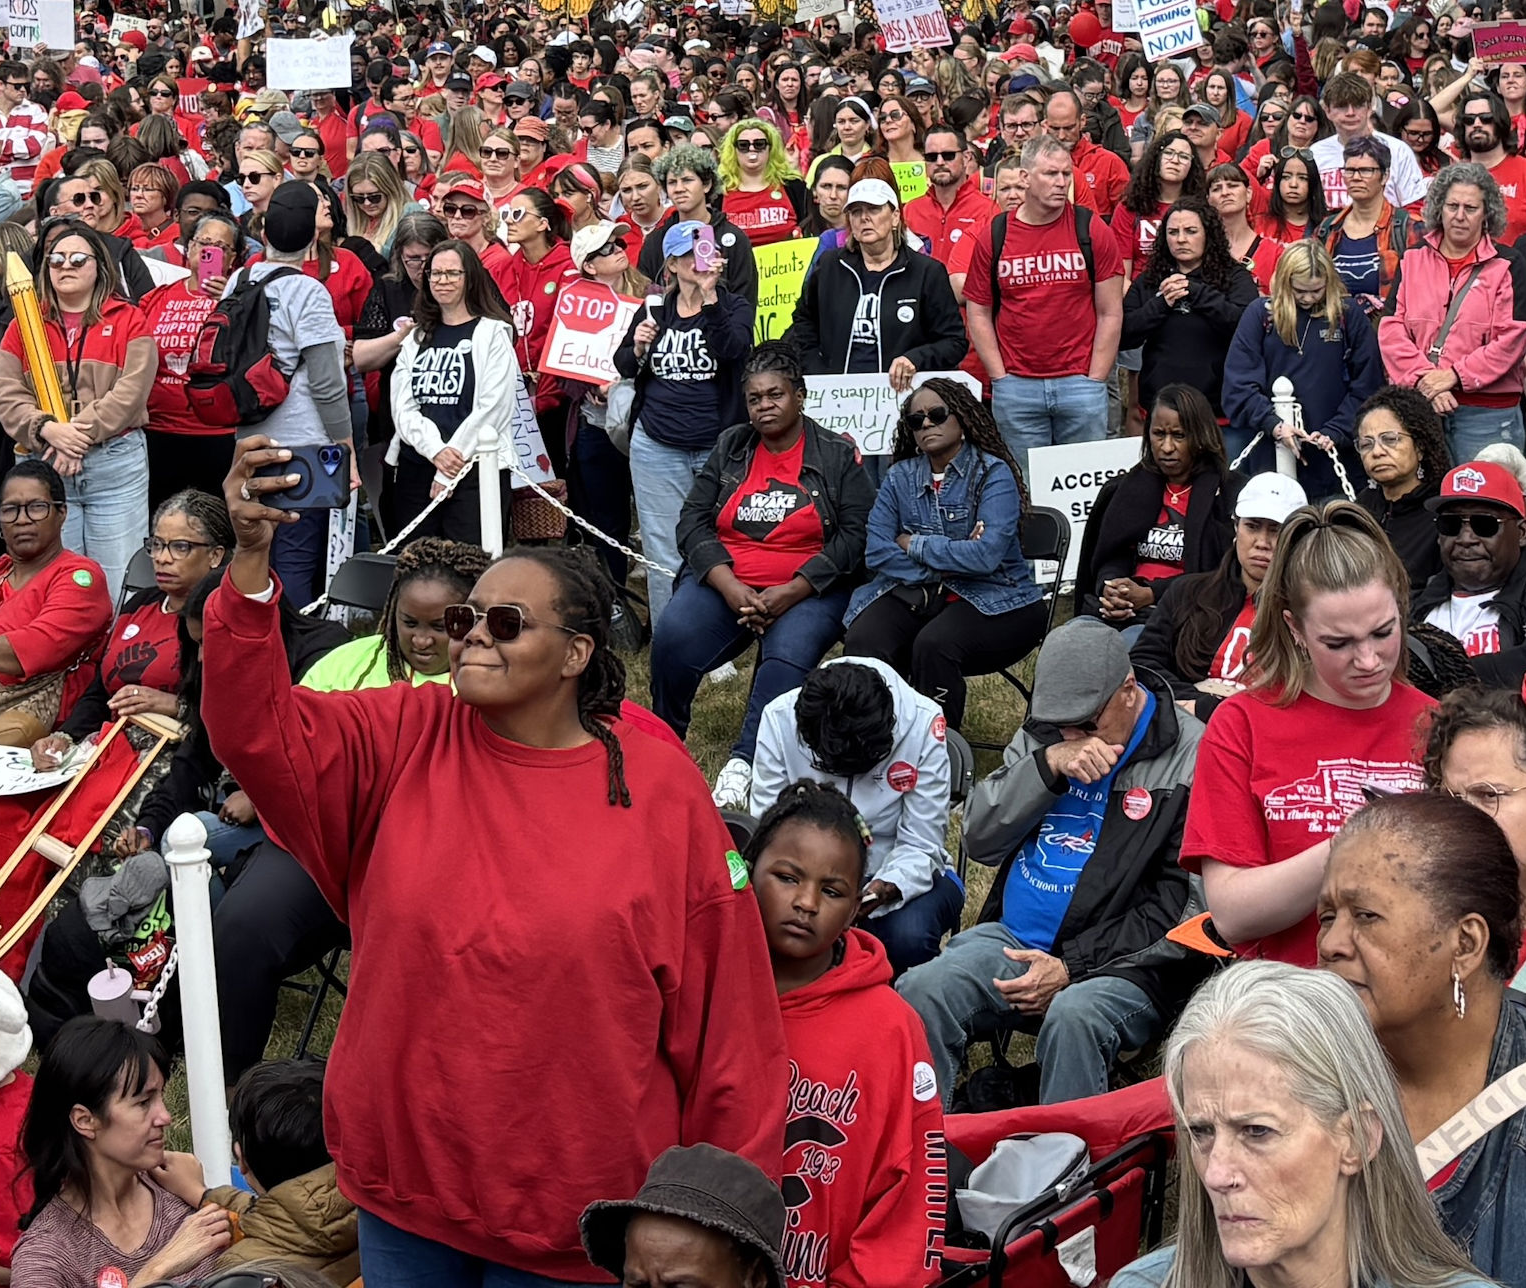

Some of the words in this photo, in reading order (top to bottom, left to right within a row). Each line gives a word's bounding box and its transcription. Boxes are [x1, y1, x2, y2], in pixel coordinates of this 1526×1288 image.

[882, 18, 906, 43] PASS
[906, 17, 917, 40] A
[1138, 6, 1191, 30] FUNDING
[1147, 26, 1194, 55] NOW
[996, 251, 1087, 279] DEFUND
[1008, 271, 1080, 286] POLITICIANS
[560, 293, 616, 321] STOP
[749, 494, 797, 509] WAKE
[737, 508, 787, 523] WINS!
